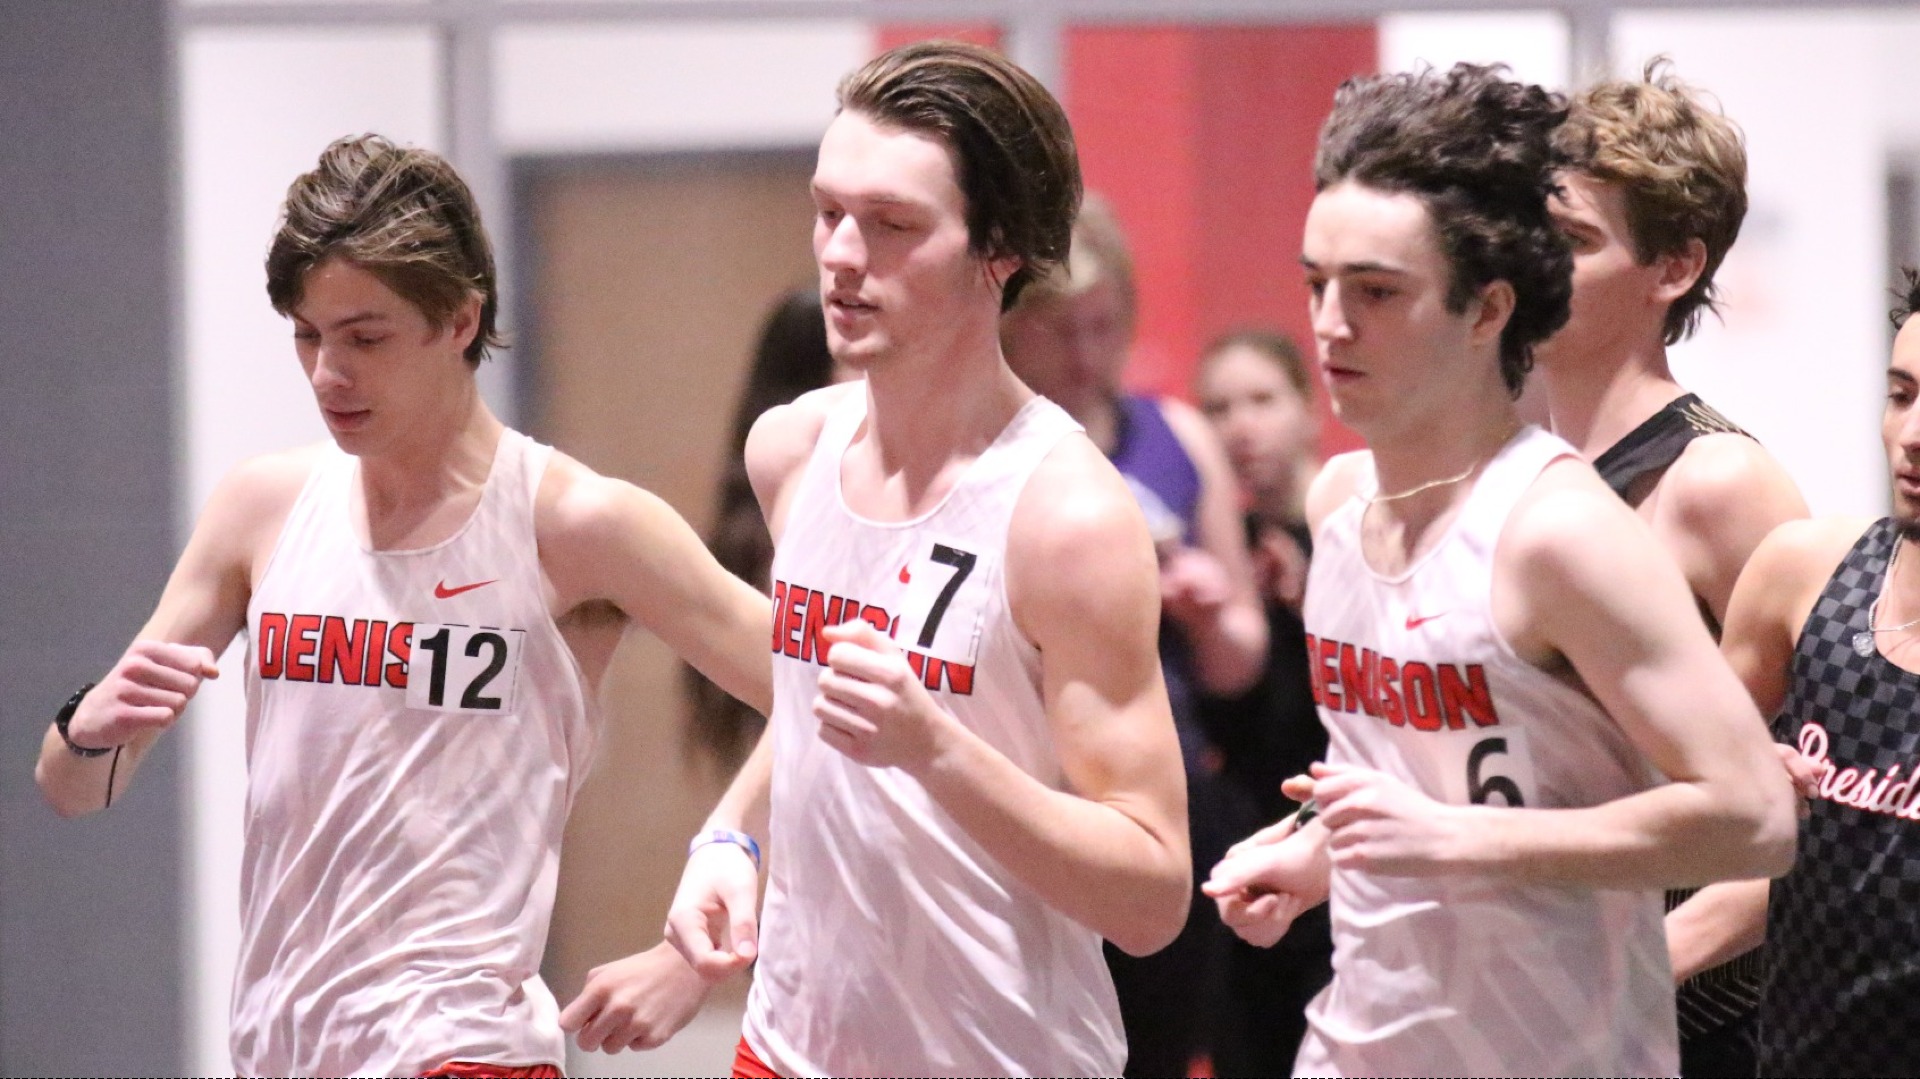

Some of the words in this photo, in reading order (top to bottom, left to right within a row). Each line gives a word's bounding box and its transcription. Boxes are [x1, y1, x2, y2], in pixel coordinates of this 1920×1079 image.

[917, 543, 977, 648] 7
[258, 612, 412, 689] DENIS
[420, 628, 508, 710] 12
[1467, 737, 1525, 807] 6
